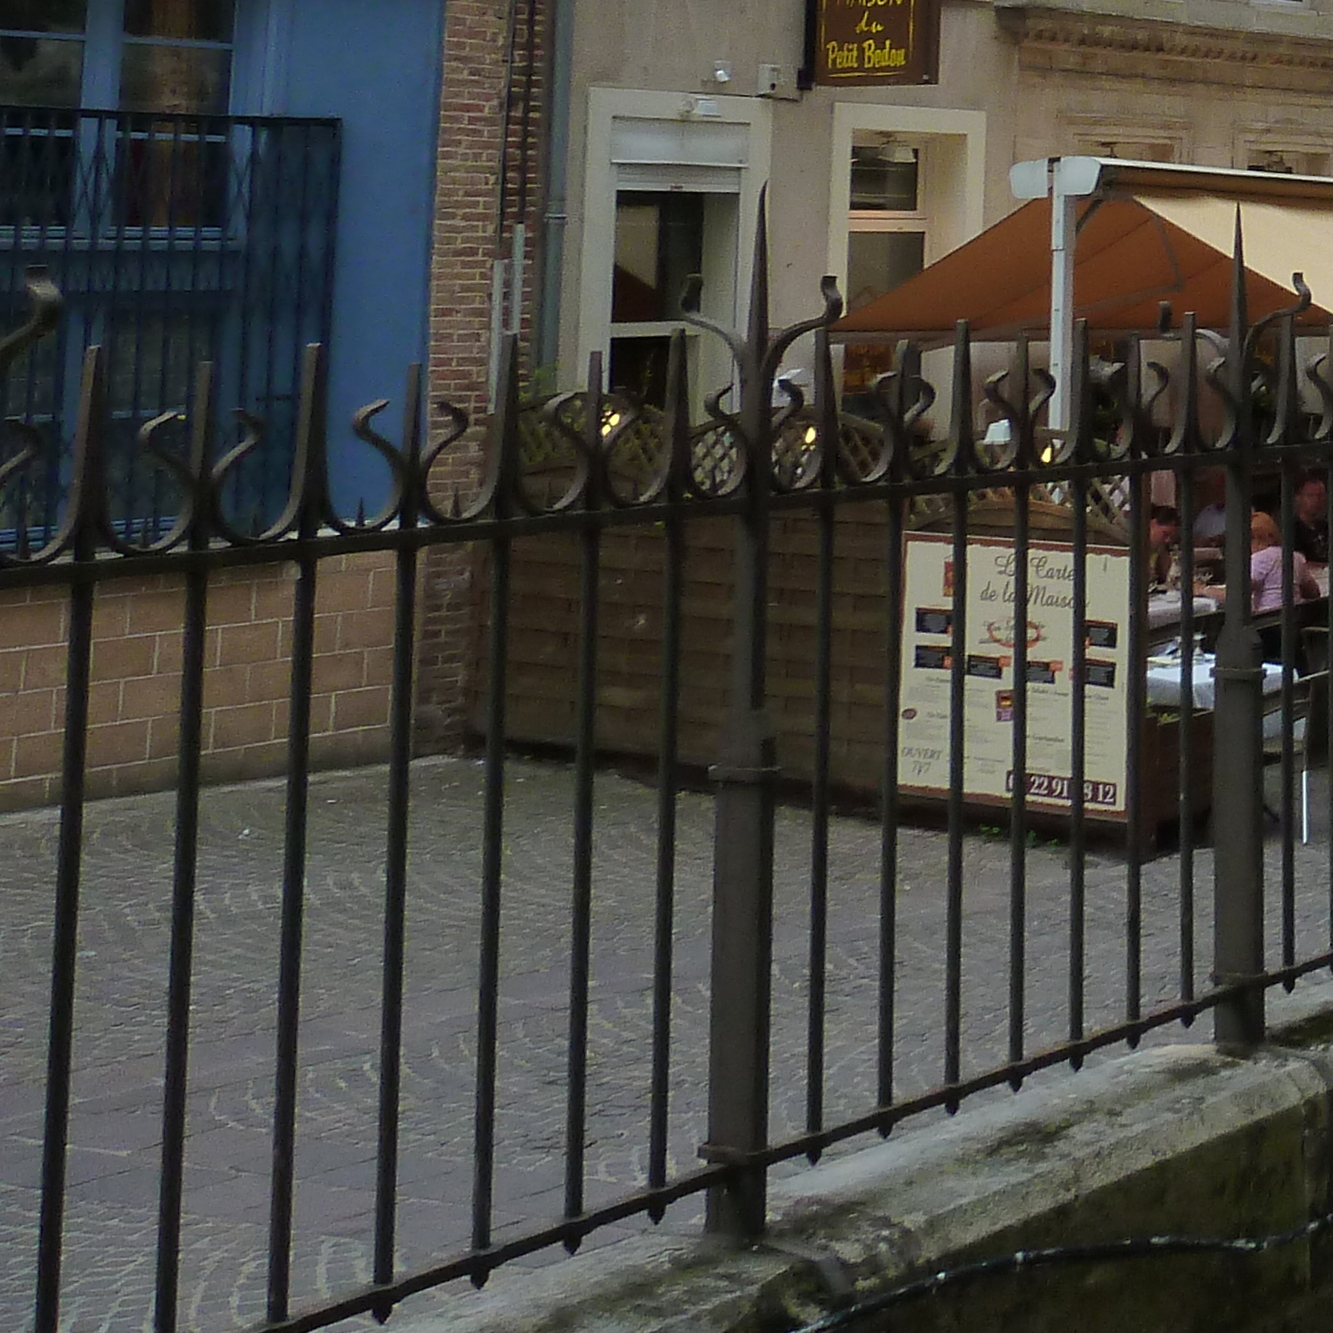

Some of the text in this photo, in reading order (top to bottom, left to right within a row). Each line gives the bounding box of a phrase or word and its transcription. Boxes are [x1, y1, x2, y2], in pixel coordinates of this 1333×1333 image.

[855, 11, 884, 33] du
[826, 41, 858, 69] Petit
[980, 580, 997, 602] de
[1029, 775, 1049, 794] 22
[1051, 778, 1069, 797] 91
[1097, 784, 1114, 802] 12
